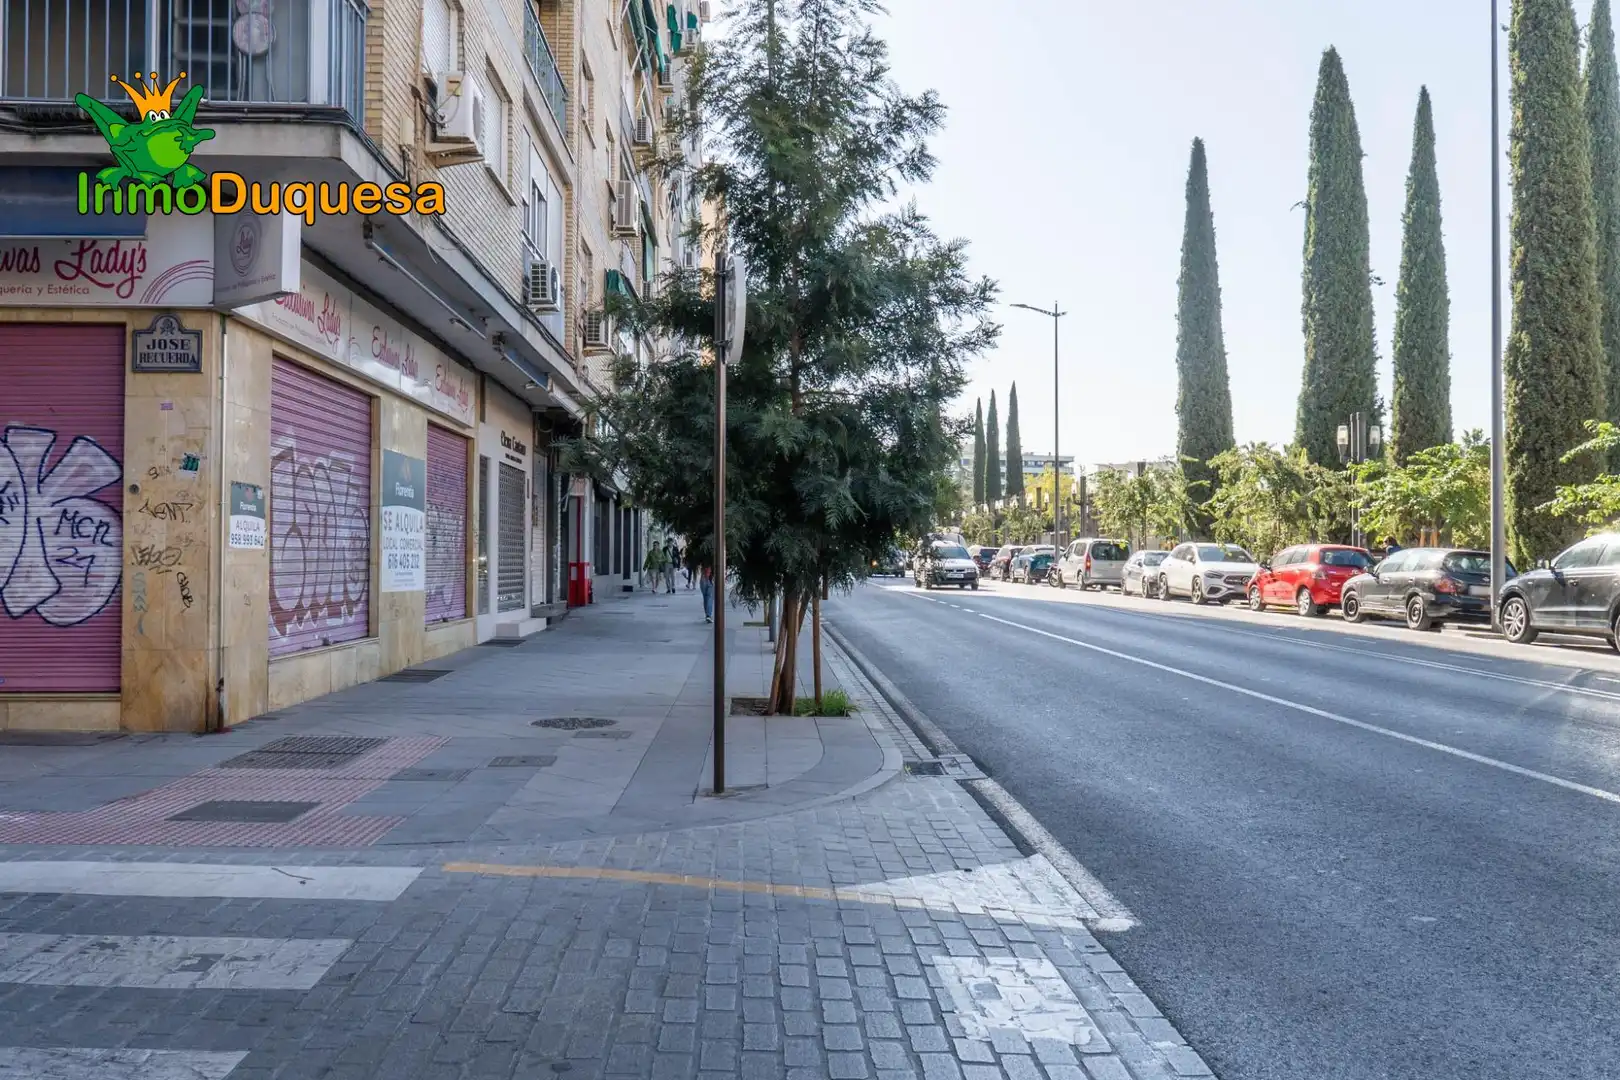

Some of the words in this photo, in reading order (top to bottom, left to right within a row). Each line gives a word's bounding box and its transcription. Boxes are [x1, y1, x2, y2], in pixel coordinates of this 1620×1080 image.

[54, 240, 147, 299] Lady's
[37, 286, 44, 296] y
[47, 283, 90, 295] Estética
[146, 338, 192, 351] JOSE
[139, 351, 198, 365] RECUERDA
[383, 509, 393, 532] SE
[395, 511, 425, 535] ALQUILA
